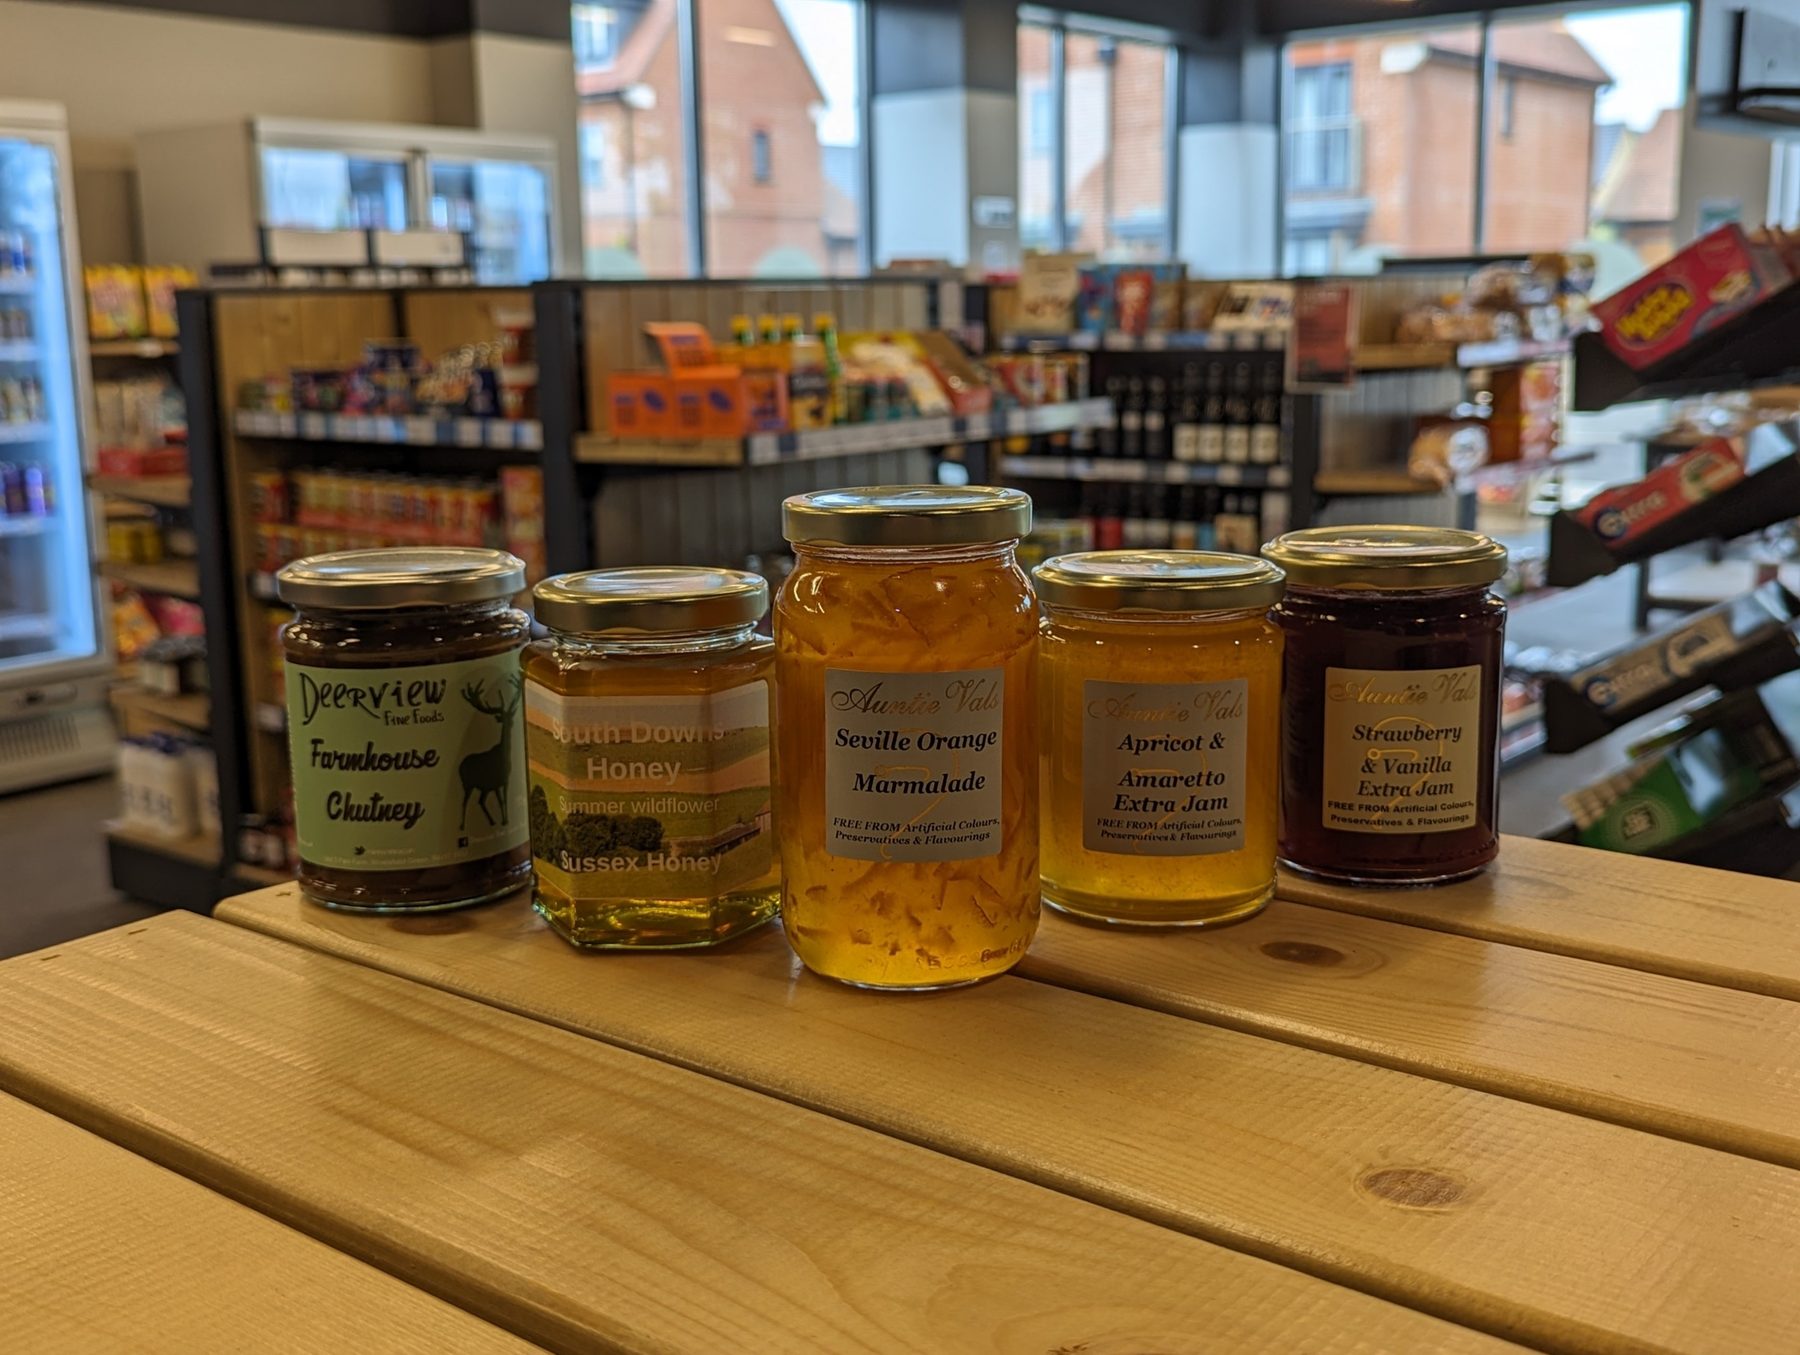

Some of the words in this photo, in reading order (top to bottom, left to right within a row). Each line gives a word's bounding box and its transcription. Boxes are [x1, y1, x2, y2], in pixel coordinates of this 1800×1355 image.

[946, 679, 999, 713] Vals
[1194, 690, 1243, 720] Vals
[413, 709, 444, 724] Foods
[553, 718, 619, 744] South
[631, 722, 725, 743] Downs
[835, 728, 910, 750] Seville
[917, 730, 997, 751] Orange
[1353, 725, 1462, 742] Strawberry
[1118, 734, 1203, 755] Apricot
[1209, 732, 1225, 749] &
[311, 738, 439, 771] Farmhouse
[588, 758, 681, 785] Honey
[1361, 758, 1376, 773] &
[1384, 755, 1451, 774] Vanilla
[853, 771, 985, 794] Marmalade
[1118, 770, 1225, 788] Amaretto
[1357, 780, 1411, 797] Extra
[1416, 781, 1453, 796] Jam
[327, 791, 425, 829] Chutney
[560, 796, 625, 814] Summer
[631, 797, 720, 813] wildflower
[1113, 794, 1175, 812] Extra
[1182, 795, 1228, 811] Jam
[1328, 801, 1354, 811] FREE
[1359, 804, 1389, 812] FROM
[1394, 804, 1437, 813] Artificial
[833, 817, 862, 829] FREE
[865, 821, 901, 831] FROM
[904, 822, 956, 833] Artificial
[1097, 818, 1124, 828] FREE
[1127, 821, 1158, 830] FROM
[1161, 820, 1204, 831] Artificial
[1331, 815, 1401, 826] Preservatives
[1418, 815, 1469, 825] Flavourings
[835, 831, 910, 844] Preservatives
[913, 836, 922, 844] &
[925, 831, 990, 845] Flavourings
[1101, 830, 1168, 841] Preservatives
[1180, 830, 1236, 841] Flavourings
[561, 850, 639, 873] Sussex
[648, 852, 723, 875] Honey
